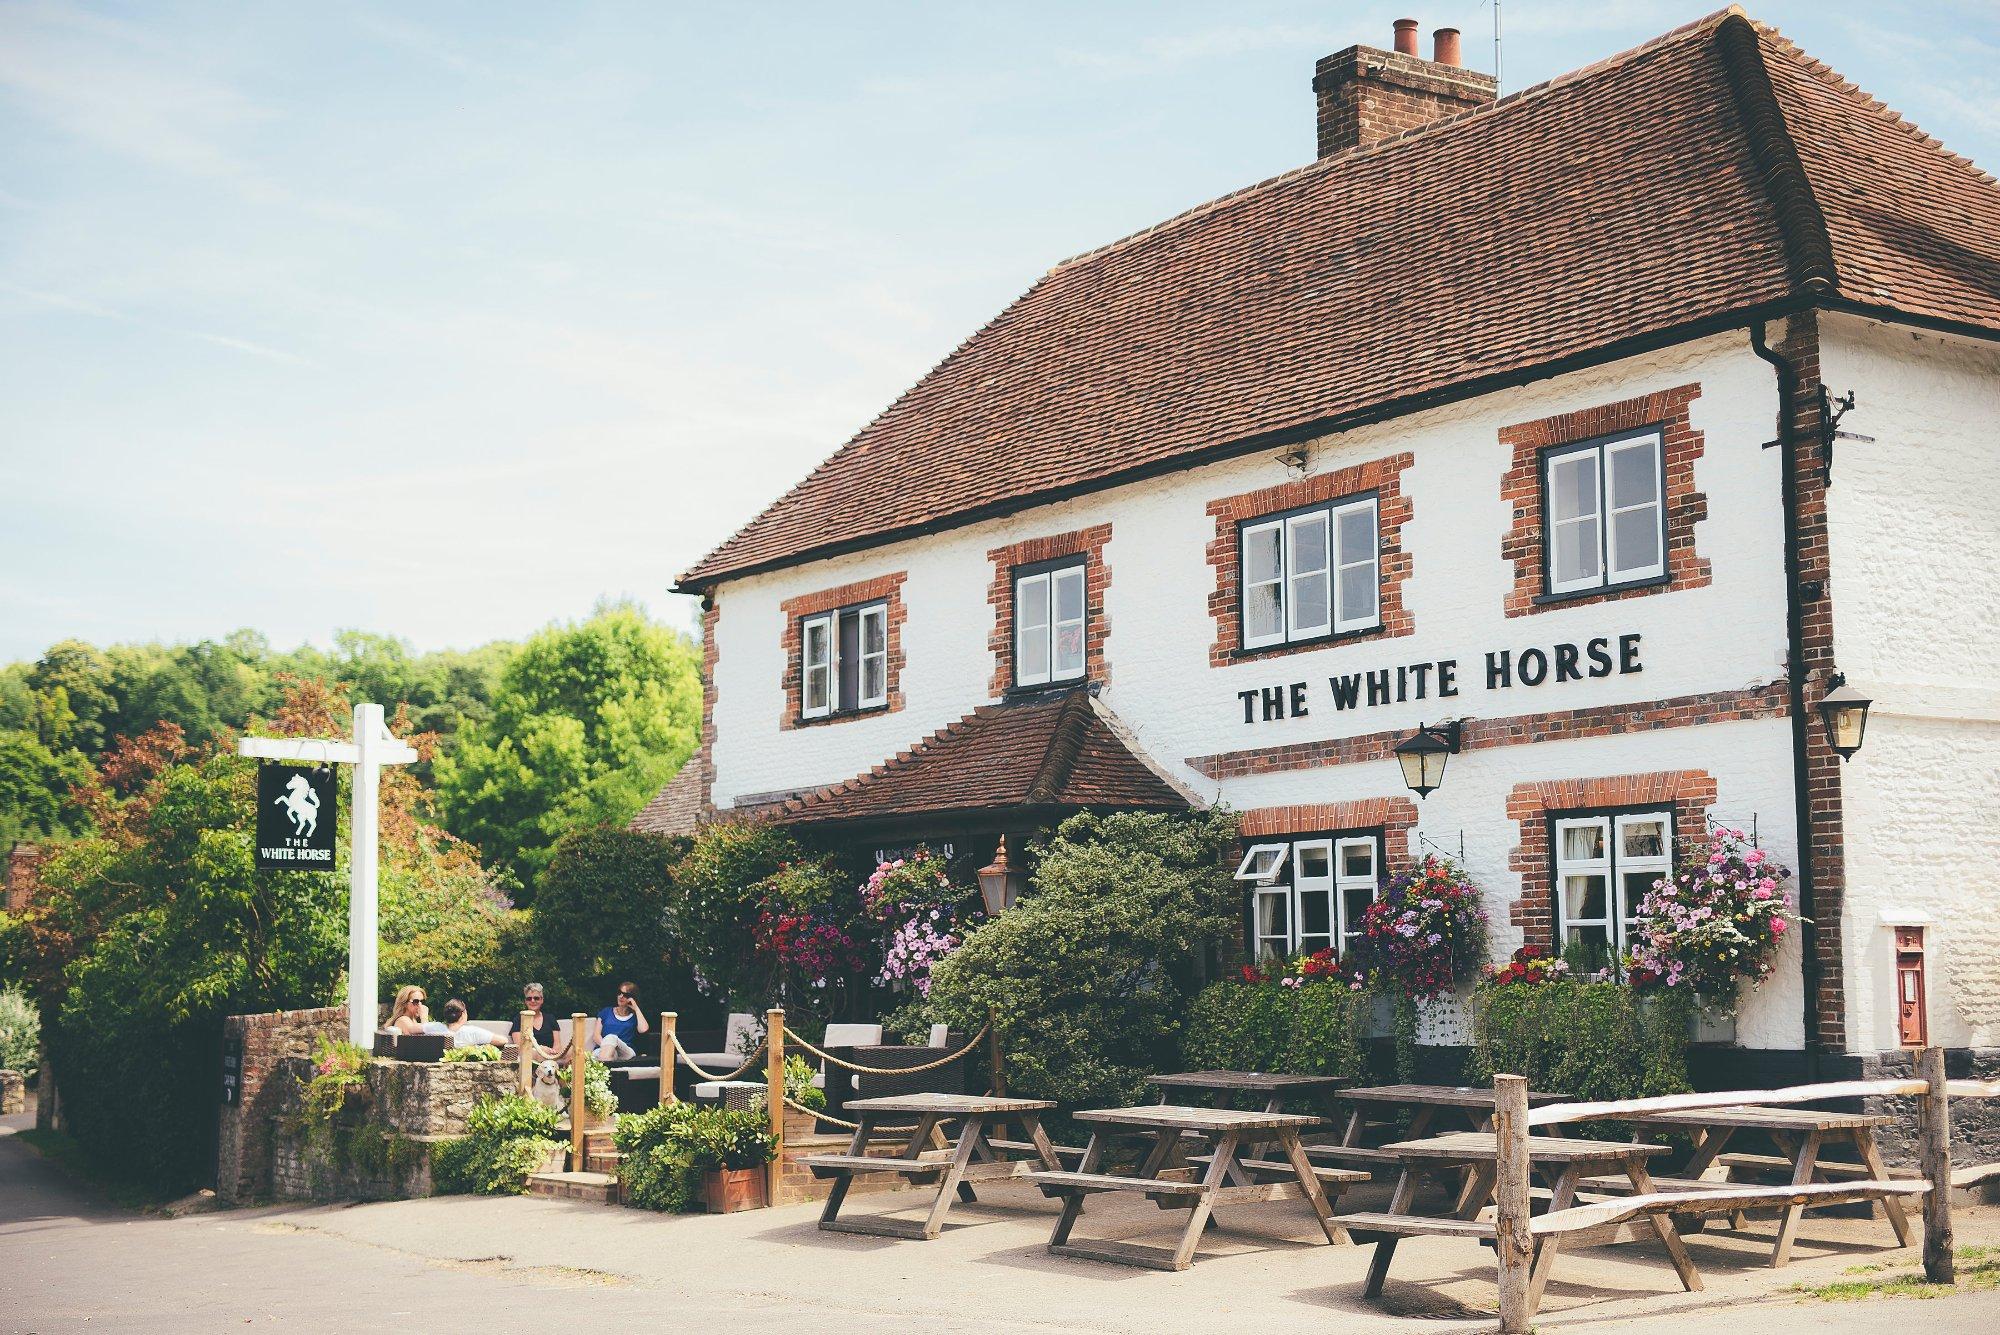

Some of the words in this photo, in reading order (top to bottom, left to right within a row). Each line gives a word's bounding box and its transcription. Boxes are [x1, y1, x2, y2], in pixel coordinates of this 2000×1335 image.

[1237, 681, 1309, 724] THE
[1328, 659, 1459, 711] WHITE
[1484, 633, 1643, 690] HORSE
[285, 837, 309, 848] THE
[260, 847, 296, 860] WHITE
[297, 848, 332, 861] HORSE
